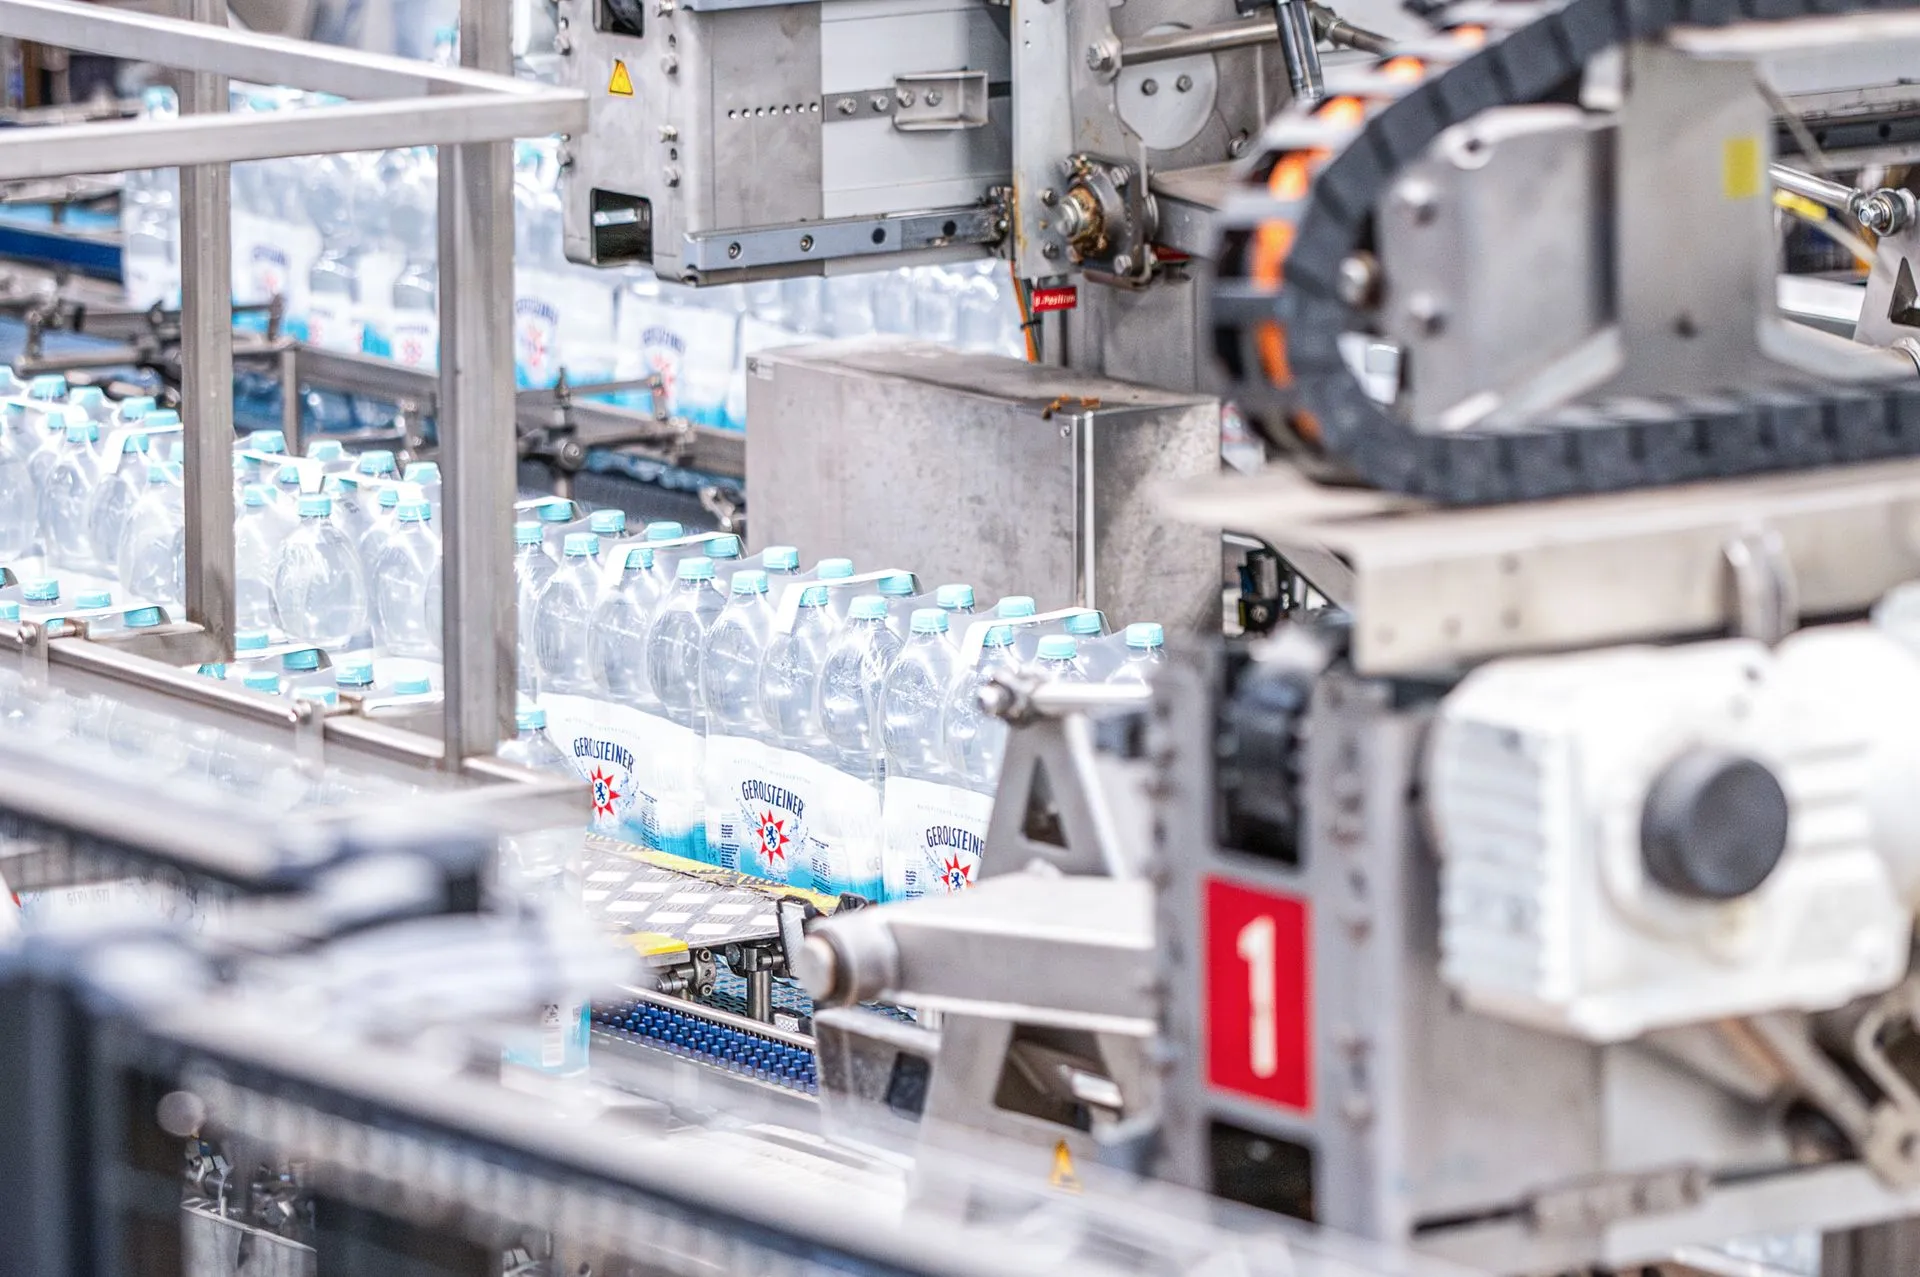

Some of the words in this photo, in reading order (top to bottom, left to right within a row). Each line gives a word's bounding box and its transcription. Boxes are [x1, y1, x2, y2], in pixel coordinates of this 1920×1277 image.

[574, 737, 633, 773] GEROLSTEINER
[742, 780, 804, 819] GEROLSTEINER
[926, 825, 985, 858] GEROLSTEINE
[1236, 914, 1278, 1079] 1
